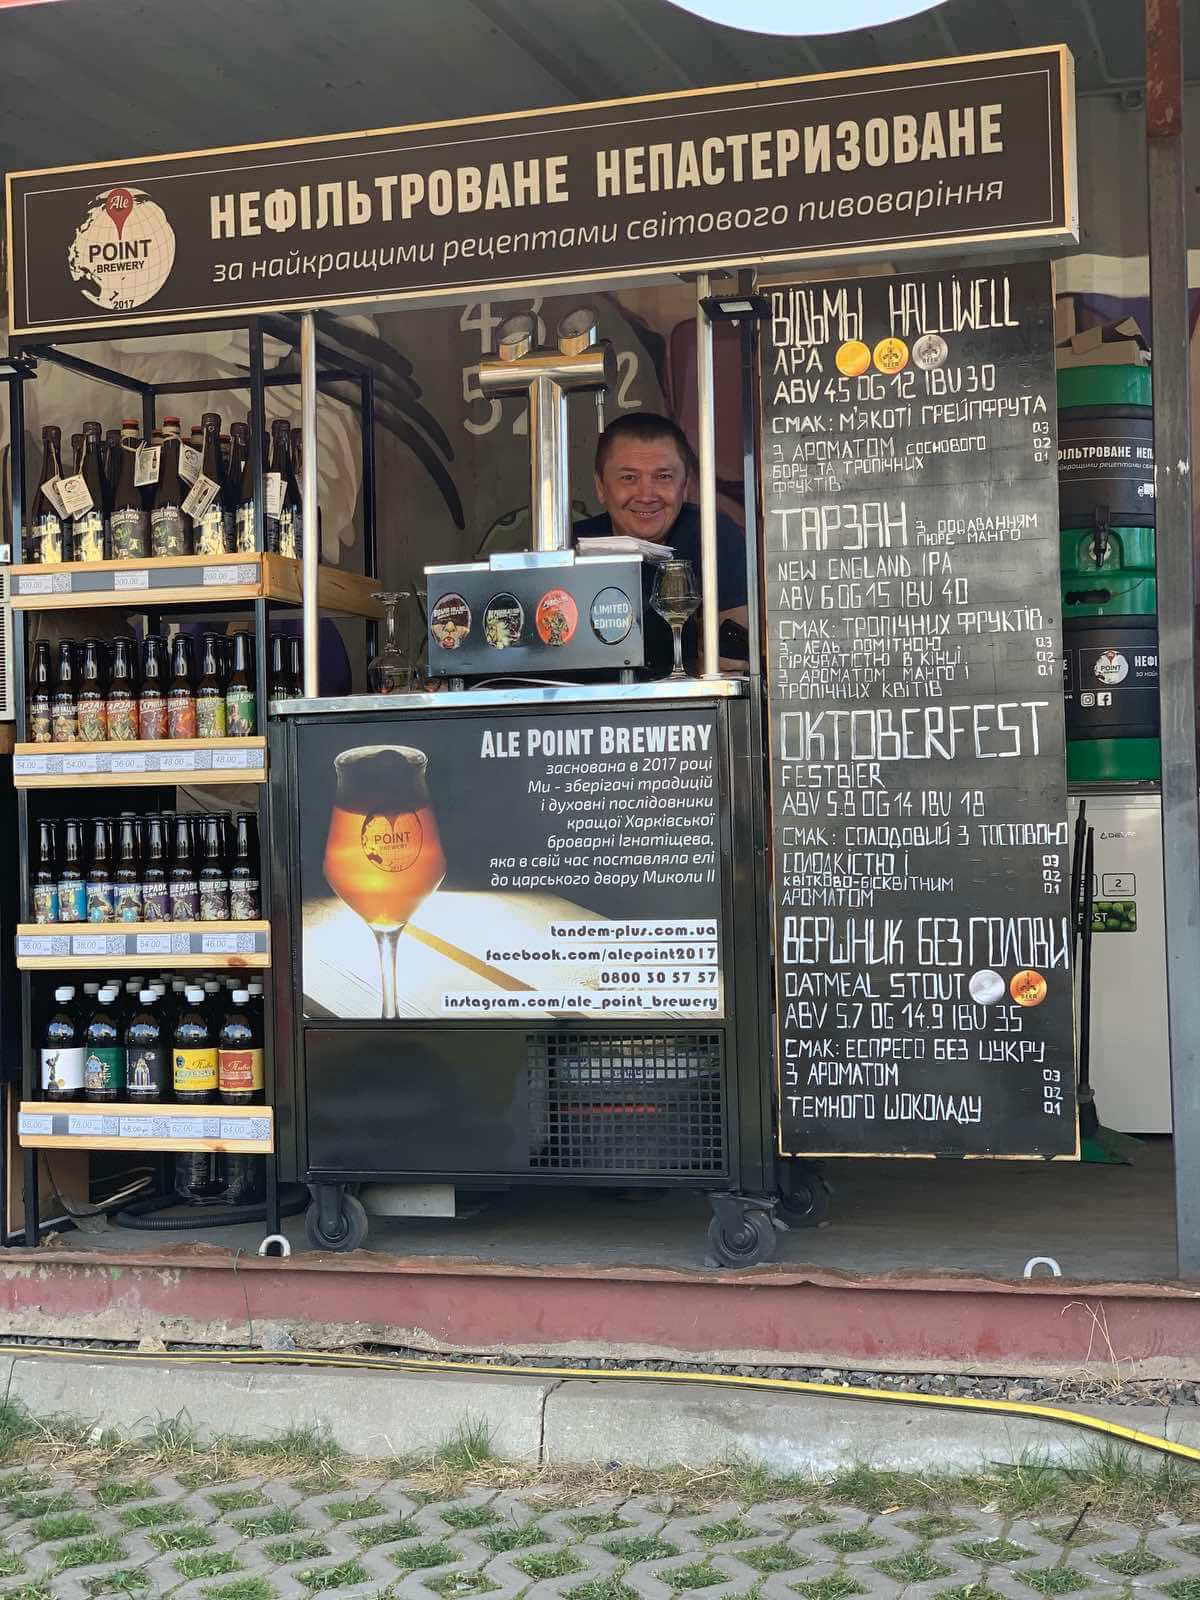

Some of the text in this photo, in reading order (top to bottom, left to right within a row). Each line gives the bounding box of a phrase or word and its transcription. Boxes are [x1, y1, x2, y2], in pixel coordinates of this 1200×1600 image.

[210, 103, 1003, 240] НЕФІЛЬТРОВАНЕ НЕПАСТЕРИЗОВАНЕ
[110, 195, 129, 209] Ale
[212, 180, 1004, 282] за найкращими рецептами світового пивоваріння
[89, 239, 152, 263] POINT
[97, 260, 145, 273] BREWERY
[113, 299, 135, 310] 2017
[889, 274, 1020, 337] HALLIWELL
[773, 344, 824, 376] APA
[773, 379, 820, 405] ABV
[857, 374, 886, 400] OG
[890, 371, 916, 400] 12
[925, 367, 962, 396] IBU
[966, 363, 996, 393] 30
[772, 395, 1047, 434] СМАК: М'ЯКОТІ ГРЕЙПФРУТА
[773, 444, 784, 463] З
[792, 437, 895, 462] АРОМАТОМ
[772, 456, 924, 479] БОРУ ТА ТРОПІЧНИХ
[772, 476, 842, 499] ФРУКТІВ
[770, 501, 908, 551] ТАРЗАН
[916, 528, 1021, 546] ПЮРЕ МАНГО
[778, 551, 952, 581] NEW ENGLAND IPA
[778, 577, 968, 610] ABV 6 OG 15 IBU 40
[594, 603, 629, 615] LIMITED
[594, 617, 631, 629] EDITION
[778, 605, 1043, 640] СМАК: ТРОПІЧНИХ ФРУКТІВ
[778, 636, 942, 655] З ЛЕДЬ ПОМІТНОЮ
[778, 645, 961, 669] ГІРКУВАТІСТЮ В КІНЦІ
[778, 669, 788, 683] З
[799, 667, 886, 683] АРОМАТОМ
[903, 666, 954, 681] МАНГО
[1101, 664, 1122, 672] POINT
[778, 680, 943, 700] ТРОПІЧНИХ КВІТІВ
[527, 728, 594, 757] POINT
[600, 724, 712, 754] BREWERY
[780, 702, 1049, 760] OKTOBERFEST
[545, 756, 713, 775] заснована в 2017 році
[782, 761, 885, 789] FESTBIER
[527, 780, 551, 794] Ми
[565, 777, 634, 795] зберігачі
[638, 775, 713, 792] традицій
[548, 797, 606, 813] духовні
[609, 795, 714, 811] послідовники
[782, 790, 985, 816] ABV 5.8 OG 14 IBU 18
[567, 813, 716, 831] кращої Харківської
[374, 832, 411, 845] POINT
[547, 833, 715, 851] броварні Ігнатіщева,
[782, 822, 1068, 848] СМАК: СОЛОДОВИЙ З ТОСТОВОЮ
[489, 851, 715, 869] яка в свій час поставляла елі
[783, 850, 895, 876] СОЛОДКІСТЮ
[491, 873, 508, 888] до
[512, 873, 590, 889] царського
[594, 871, 639, 888] двору
[642, 870, 703, 885] Миколи
[783, 873, 954, 892] КВІТКОВО-БІСКВІТНИМ
[1115, 878, 1122, 887] 2
[782, 888, 873, 908] АРОМАТОМ
[551, 924, 717, 939] tandem-plus.com.ua
[783, 916, 1069, 969] ВЕРШНИК БЕЗ ГОЛОВИ
[486, 947, 717, 962] facebook.com/alepoint2017
[601, 972, 641, 984] 0800
[672, 972, 691, 984] 57
[697, 972, 717, 984] 57
[785, 972, 966, 1001] OATMEAL STOUT
[444, 995, 718, 1011] instagram.com/ale_point_brewery
[784, 1002, 1023, 1032] ABV 5.7 OG 14.9 IBU 35
[785, 1037, 1045, 1063] СМАК: ЕСПРЕСО БЕЗ ЦУКРУ
[785, 1062, 899, 1086] З АРОМАТОМ
[787, 1094, 982, 1124] ТЕМНОГО ШОКОЛАДУ
